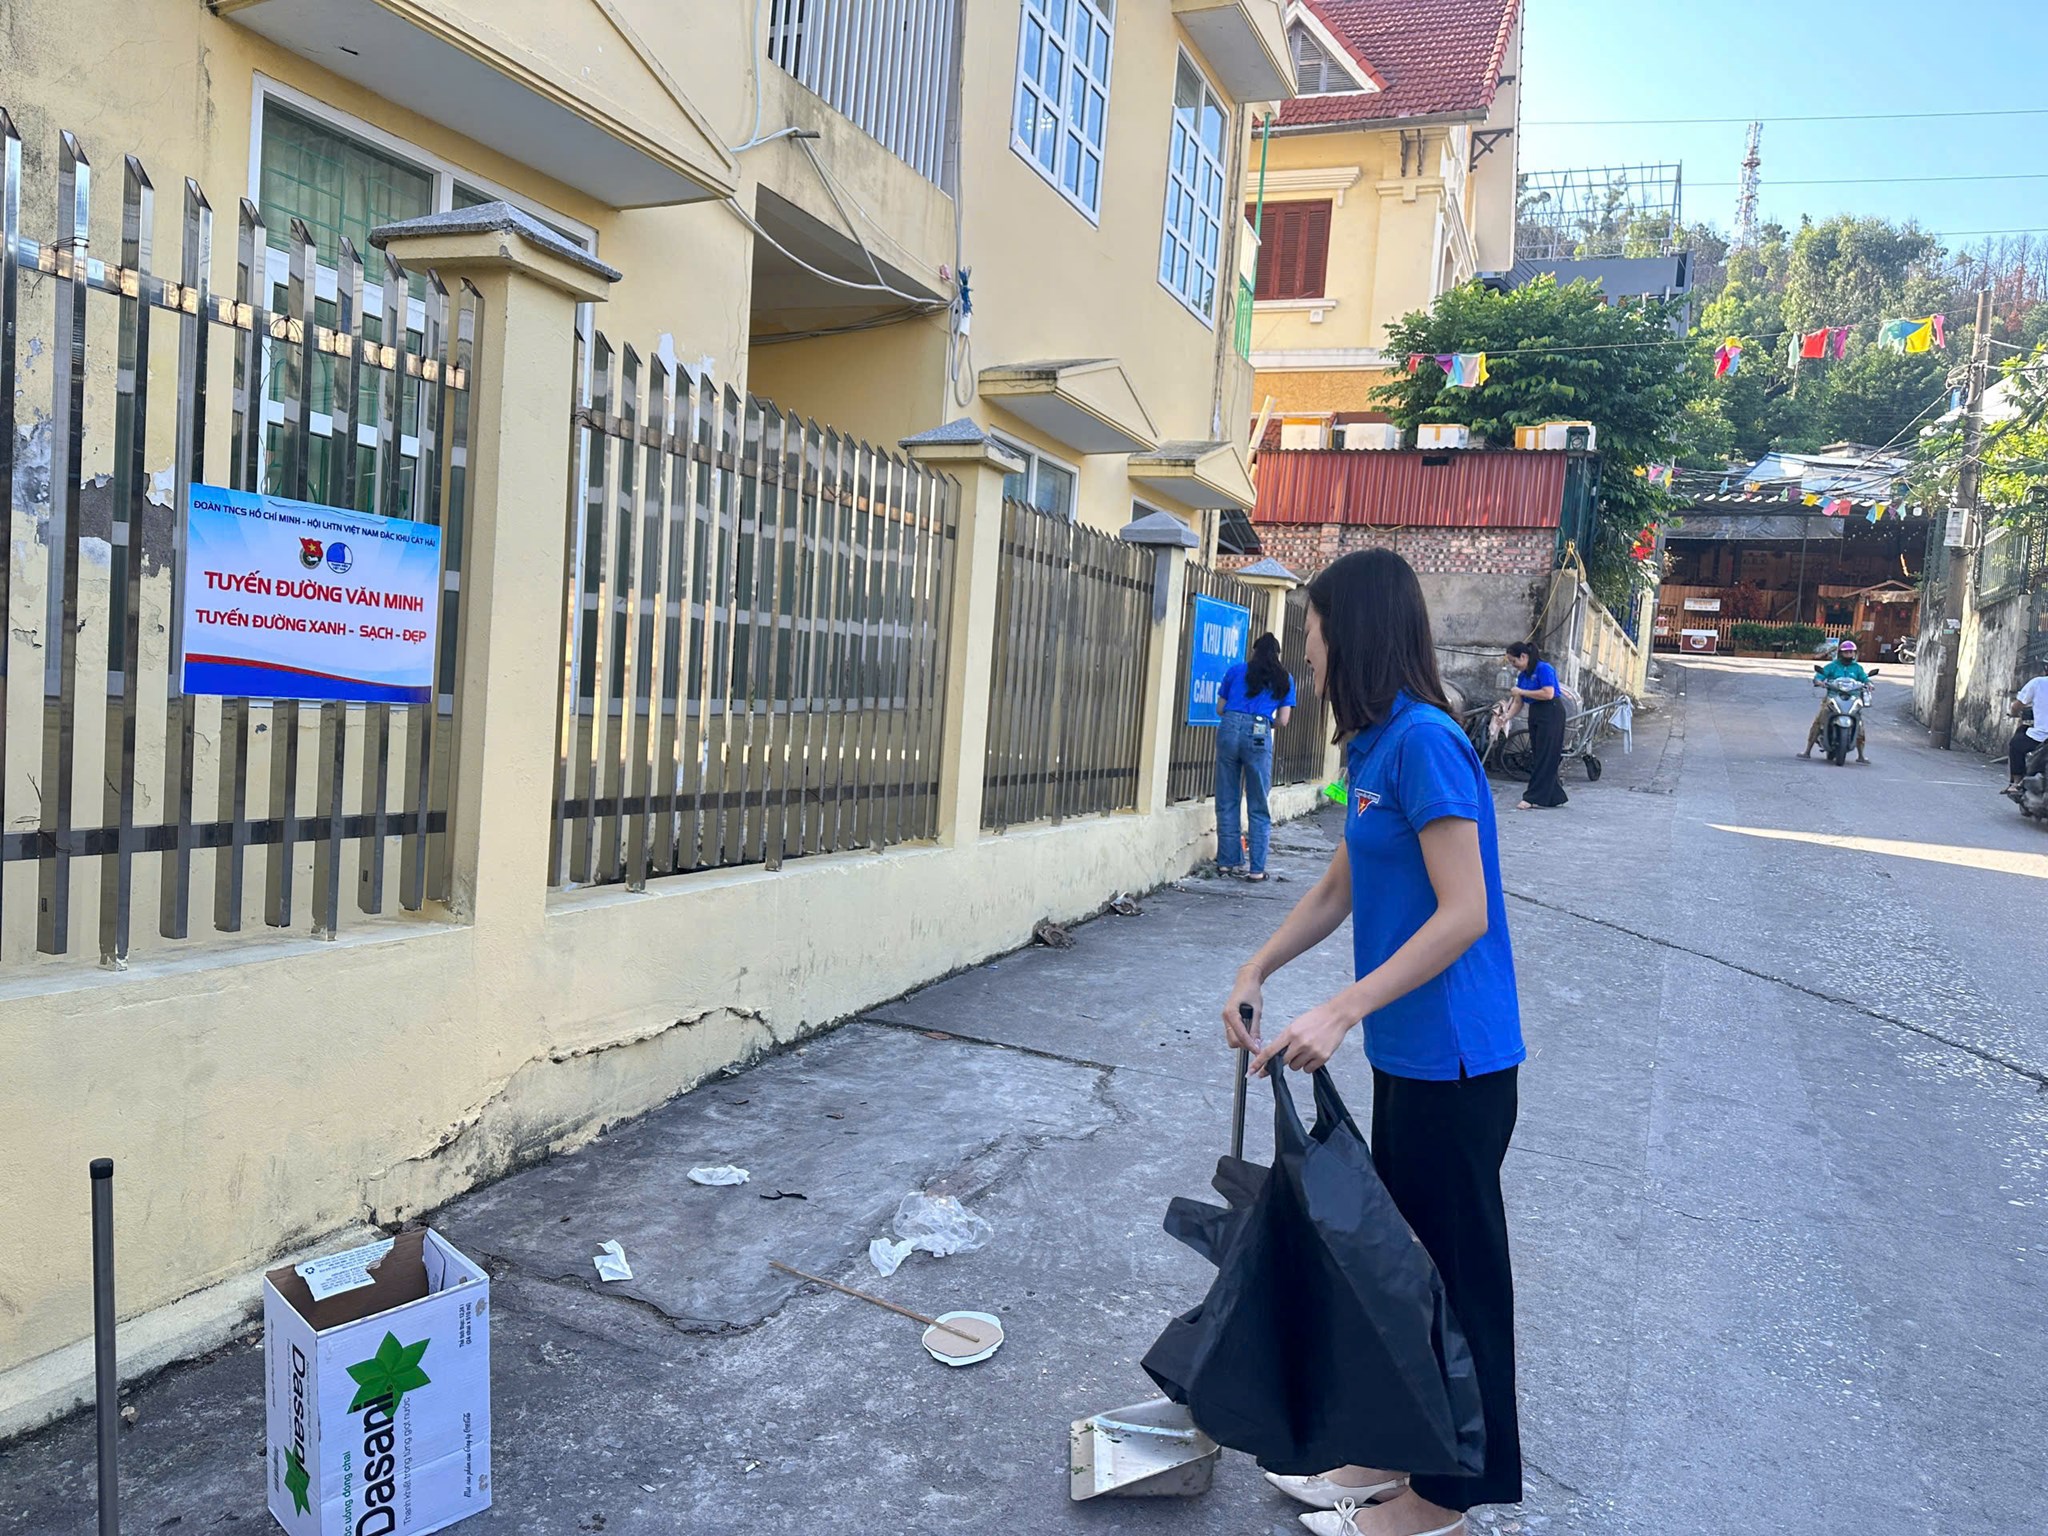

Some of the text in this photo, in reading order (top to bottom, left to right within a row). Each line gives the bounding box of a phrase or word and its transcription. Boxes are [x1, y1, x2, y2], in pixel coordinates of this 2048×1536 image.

[194, 500, 220, 512] ĐOÀN
[223, 505, 247, 516] TNCS
[249, 508, 262, 519] HỒ
[263, 511, 278, 521] CHÍ
[278, 514, 301, 525] MINH
[307, 518, 321, 529] HỘI
[322, 521, 342, 531] LHTN
[343, 524, 361, 535] VIỆT
[361, 528, 379, 537] NAM
[380, 531, 395, 541] ĐẶC
[396, 534, 410, 543] KHU
[411, 536, 424, 545] CÁT
[204, 570, 424, 612] TUYẾN ĐƯỜNG VĂN MINH
[195, 608, 249, 628] TUYẾN
[252, 614, 307, 633] ĐƯỜNG
[308, 619, 346, 636] XANH
[359, 625, 394, 642] SẠCH
[402, 628, 427, 645] ĐẸP
[1202, 621, 1240, 664] KHU VỰC
[1193, 672, 1214, 703] CẤM
[292, 1343, 310, 1479] Dasani
[342, 1451, 352, 1472] chai
[352, 1391, 396, 1536] Dasani
